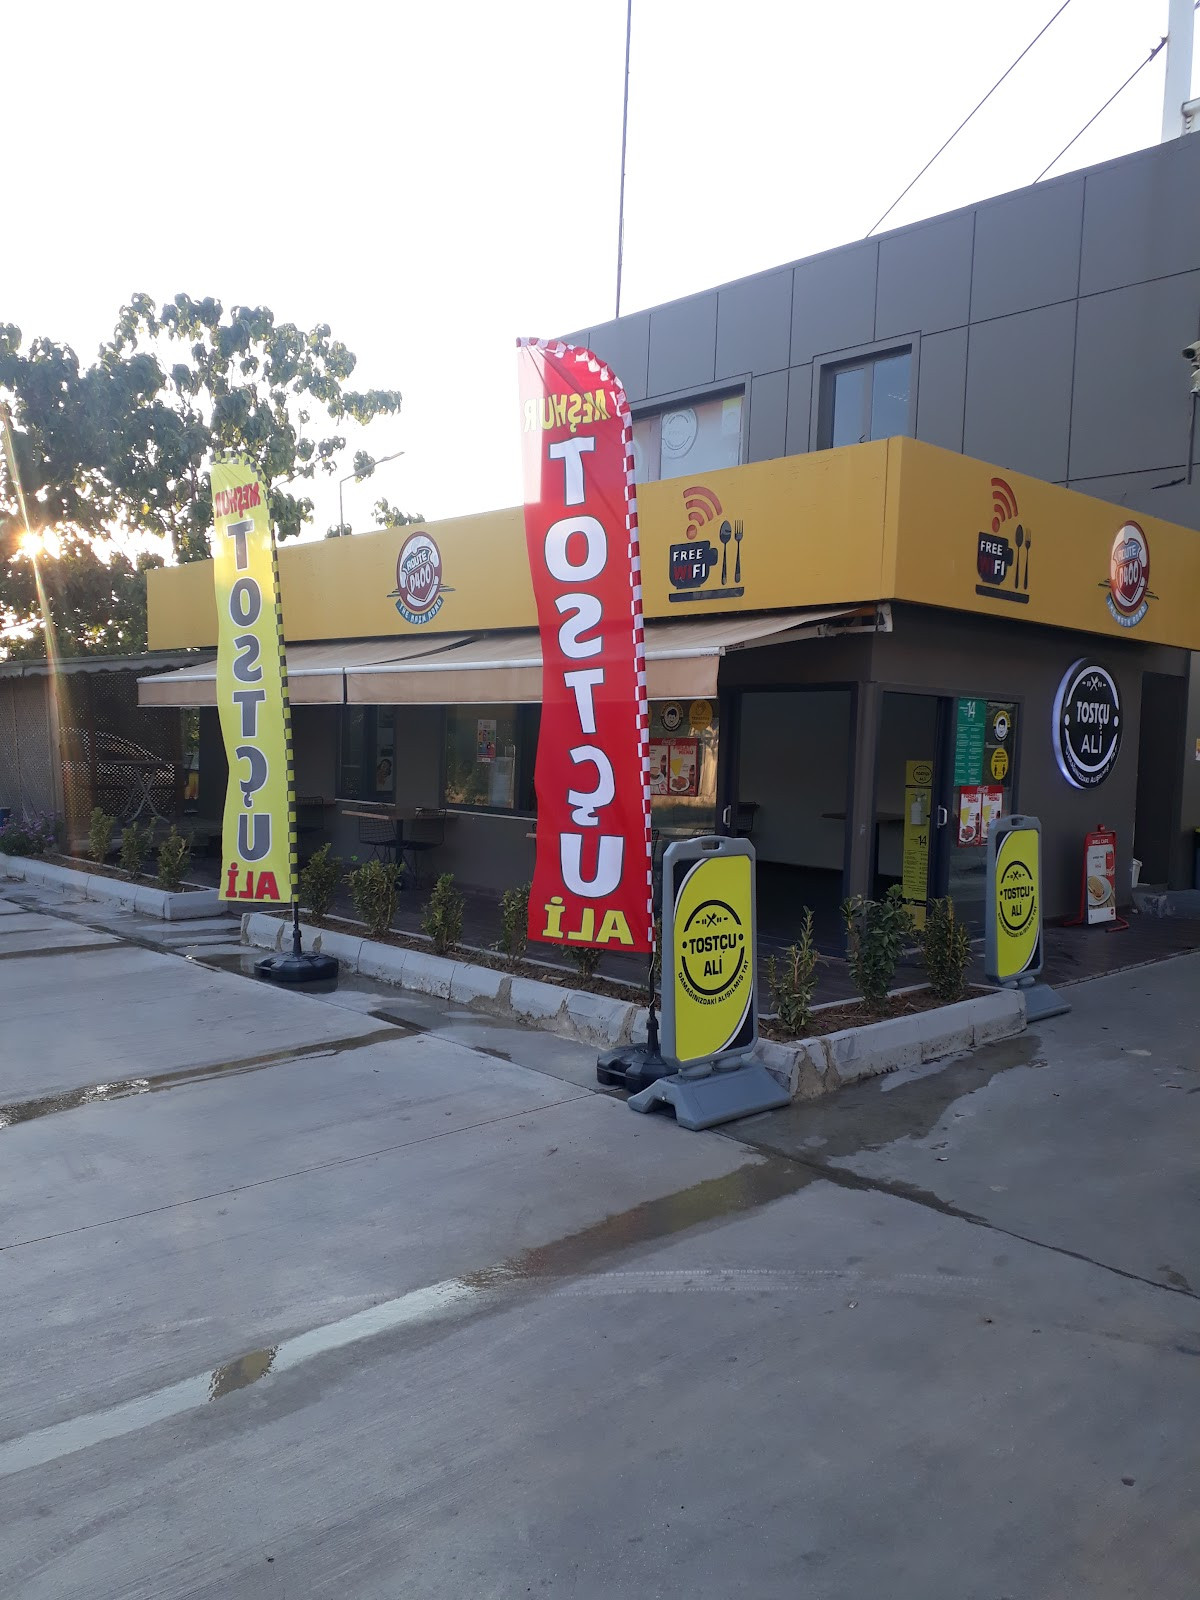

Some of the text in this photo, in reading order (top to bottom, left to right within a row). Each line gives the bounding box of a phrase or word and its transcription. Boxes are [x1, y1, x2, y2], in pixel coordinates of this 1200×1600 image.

[673, 549, 703, 562] FREE
[980, 540, 1003, 556] FREE
[1117, 545, 1137, 562] ROUTE
[406, 550, 428, 571] ROUTE
[409, 563, 431, 593] D400
[673, 563, 706, 580] WIFI
[967, 701, 976, 718] 14
[1076, 701, 1110, 729] TOSTÇU
[1081, 731, 1102, 753] ALİ
[918, 835, 927, 846] 14
[1011, 901, 1022, 916] ALİ
[689, 933, 736, 954] TOSTÇU
[703, 955, 722, 977] ALİ
